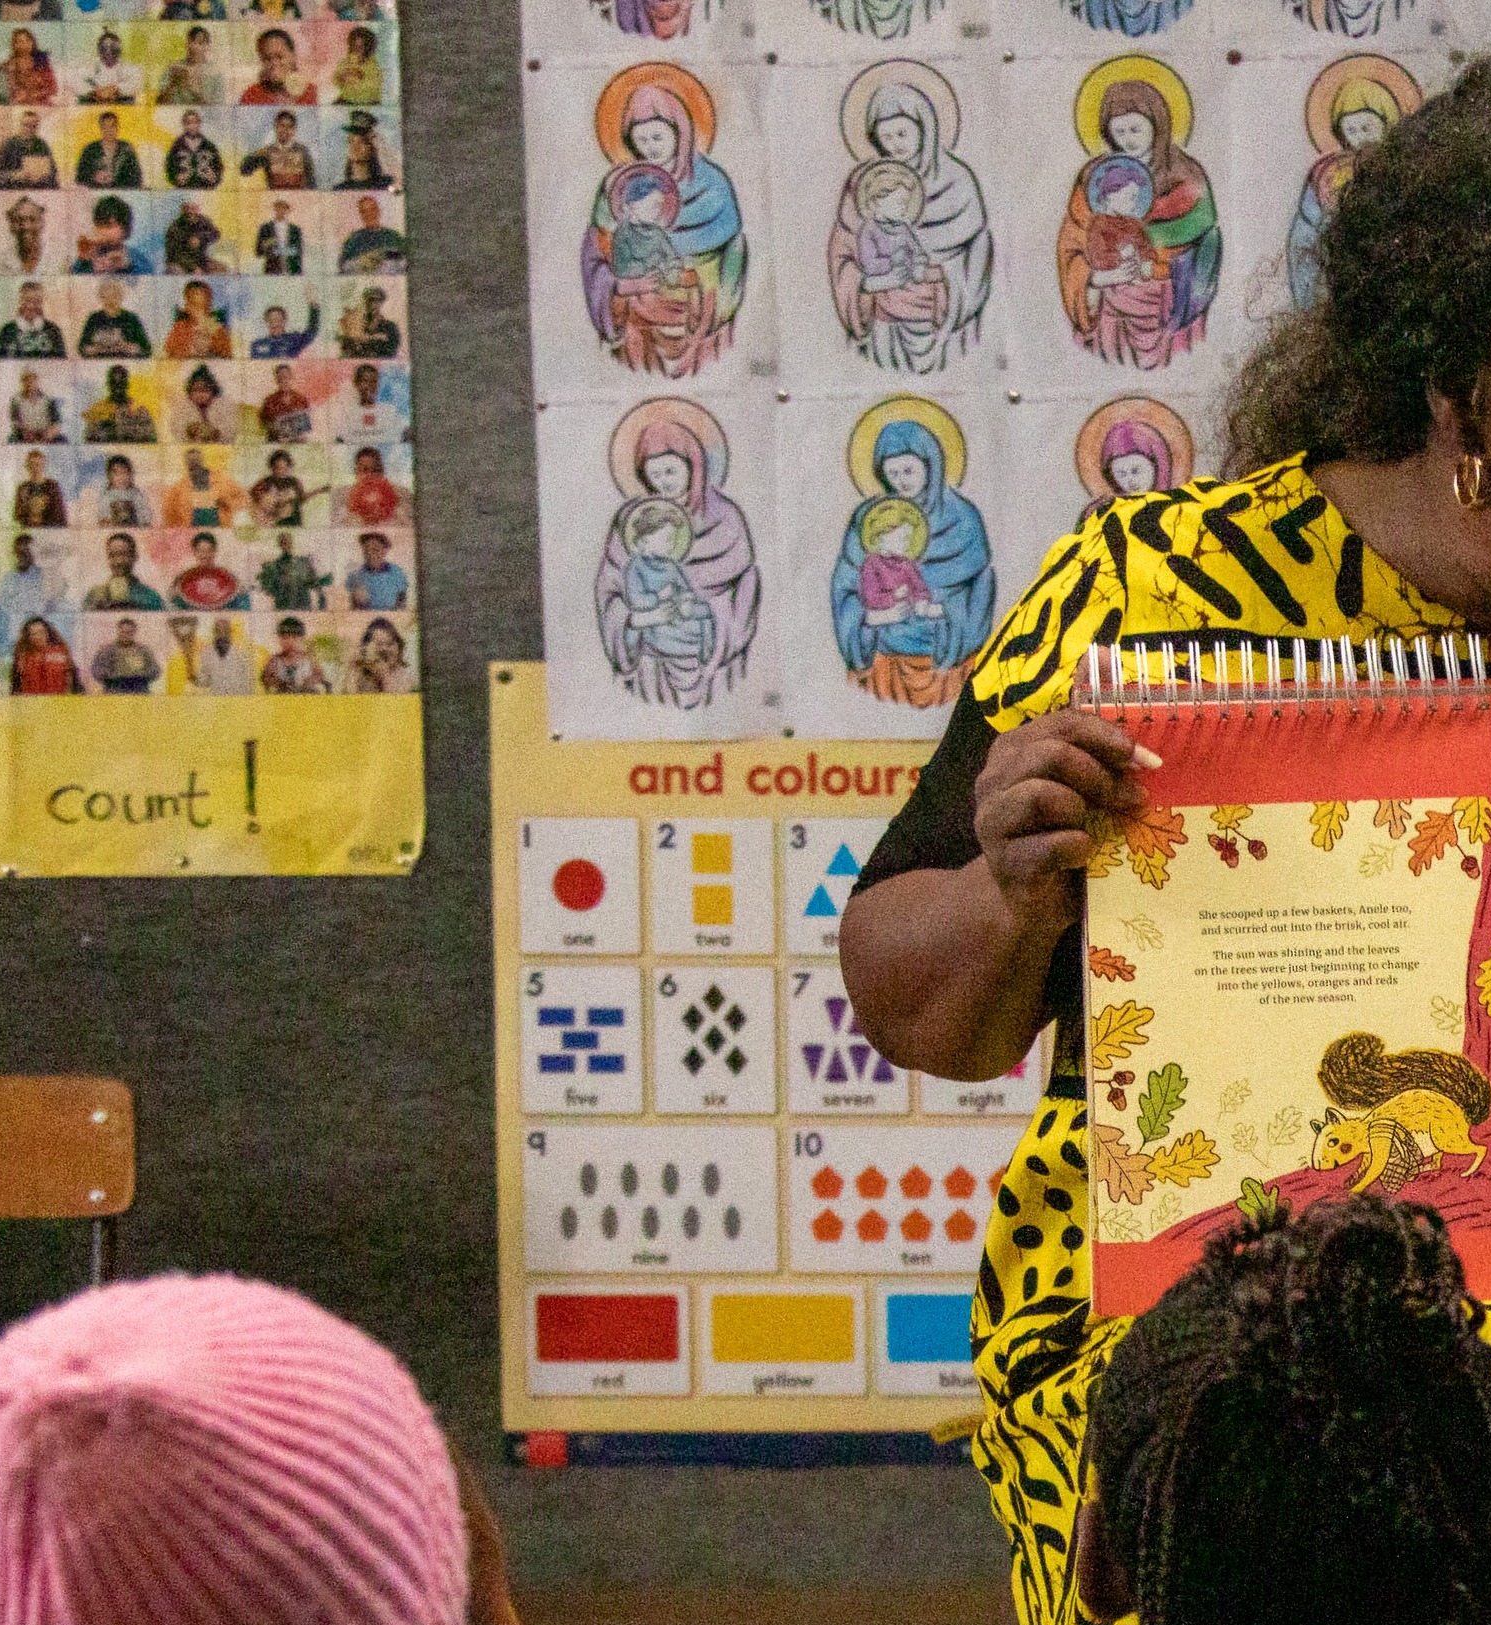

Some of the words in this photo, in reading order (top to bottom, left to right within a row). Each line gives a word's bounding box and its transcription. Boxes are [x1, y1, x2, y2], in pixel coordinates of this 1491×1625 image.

[628, 752, 723, 796] and
[659, 823, 678, 849] 2
[790, 823, 806, 850] 3
[1199, 910, 1218, 920] She
[1220, 908, 1263, 922] scooped
[1266, 908, 1279, 918] up
[1291, 907, 1309, 916] few
[1312, 906, 1356, 916] baskets,
[1391, 904, 1412, 915] too,
[1201, 925, 1221, 935] and
[1223, 924, 1268, 934] scurried
[1271, 923, 1287, 933] out
[1291, 922, 1312, 932] into
[1315, 922, 1333, 931] the
[1335, 920, 1365, 931] brisk,
[1368, 920, 1390, 929] cool
[1393, 919, 1410, 929] air.
[563, 934, 595, 946] one
[694, 934, 731, 946] two
[1213, 950, 1233, 960] The
[1236, 951, 1255, 959] sun
[1257, 949, 1278, 958] was
[1281, 948, 1322, 959] shining
[1325, 946, 1345, 956] and
[1348, 946, 1365, 955] the
[1367, 945, 1400, 955] leaves
[1194, 968, 1208, 976] on
[1211, 966, 1228, 975] the
[1231, 966, 1257, 974] trees
[1260, 965, 1287, 973] were
[1288, 964, 1308, 975] just
[1311, 961, 1365, 973] beginning
[1368, 962, 1379, 970] to
[1381, 960, 1420, 971] change
[526, 972, 543, 998] 5
[659, 972, 677, 998] 6
[792, 972, 811, 997] 7
[1217, 982, 1239, 991] into
[1241, 980, 1258, 990] the
[1261, 979, 1305, 991] yellows,
[1308, 978, 1350, 989] oranges
[1353, 976, 1372, 986] and
[1375, 976, 1398, 985] reds
[1259, 995, 1271, 1005] of
[1273, 995, 1290, 1004] the
[1293, 995, 1315, 1003] new
[1318, 993, 1357, 1002] season.
[565, 1091, 599, 1107] five
[702, 1092, 727, 1107] six
[821, 1092, 875, 1107] seven
[958, 1092, 1005, 1112] eight
[526, 1132, 545, 1155] 9
[793, 1131, 823, 1157] 10
[631, 1252, 669, 1264] nine
[901, 1252, 931, 1265] ten
[592, 1374, 625, 1388] red
[753, 1374, 814, 1395] yellow
